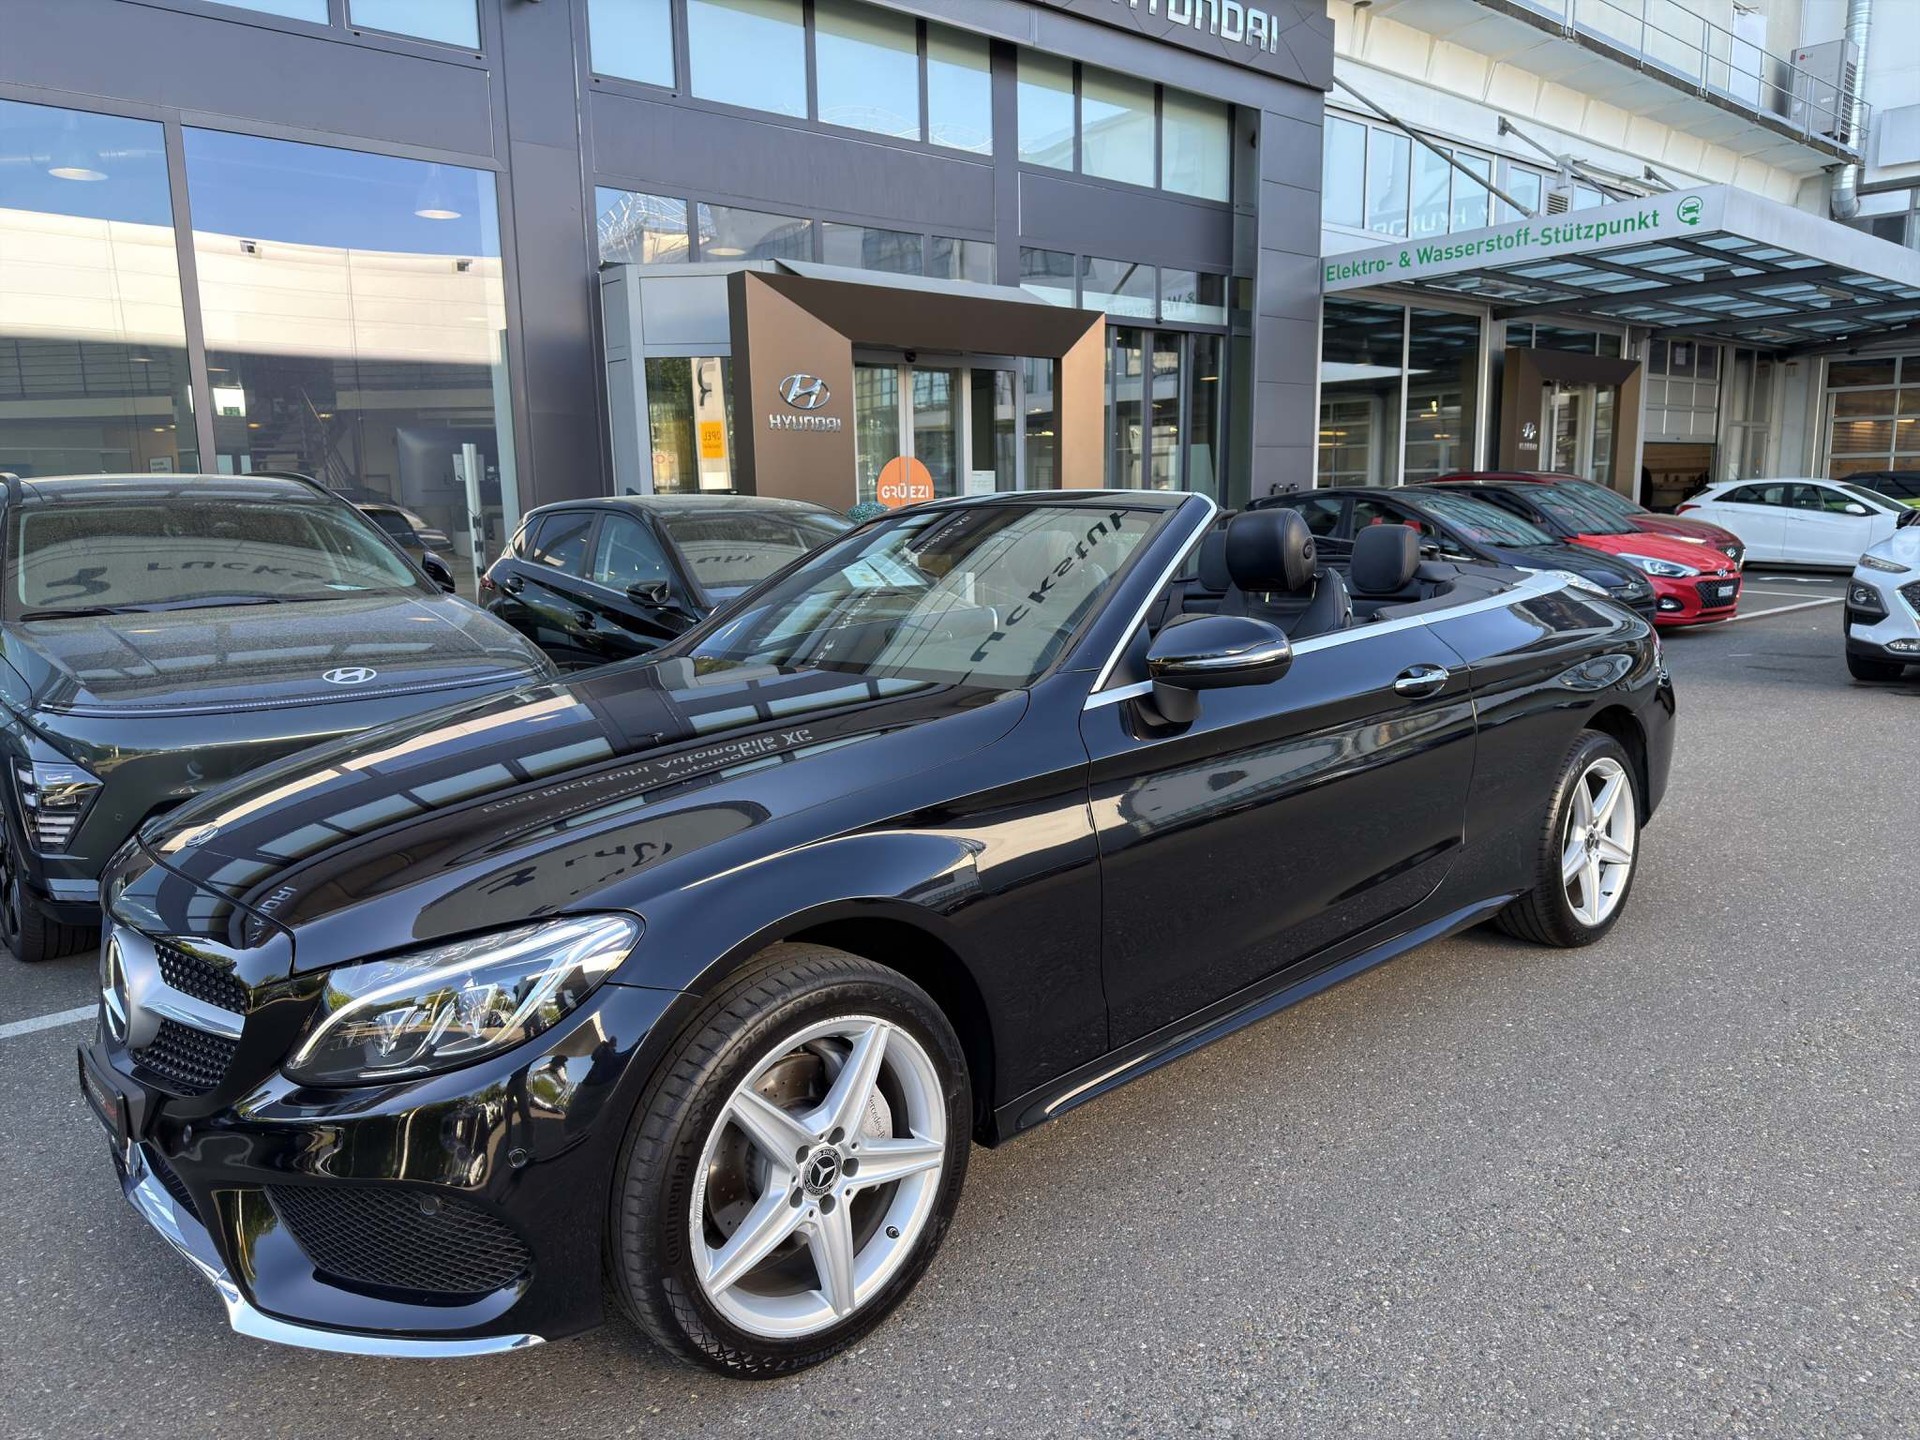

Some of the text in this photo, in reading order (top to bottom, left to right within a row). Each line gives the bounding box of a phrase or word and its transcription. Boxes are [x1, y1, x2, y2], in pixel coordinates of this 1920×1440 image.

[1111, 0, 1278, 54] UNDAI
[1326, 208, 1660, 282] Elektro- & Wasserstoff-Stützpunkt
[769, 414, 841, 432] HYUNDAI
